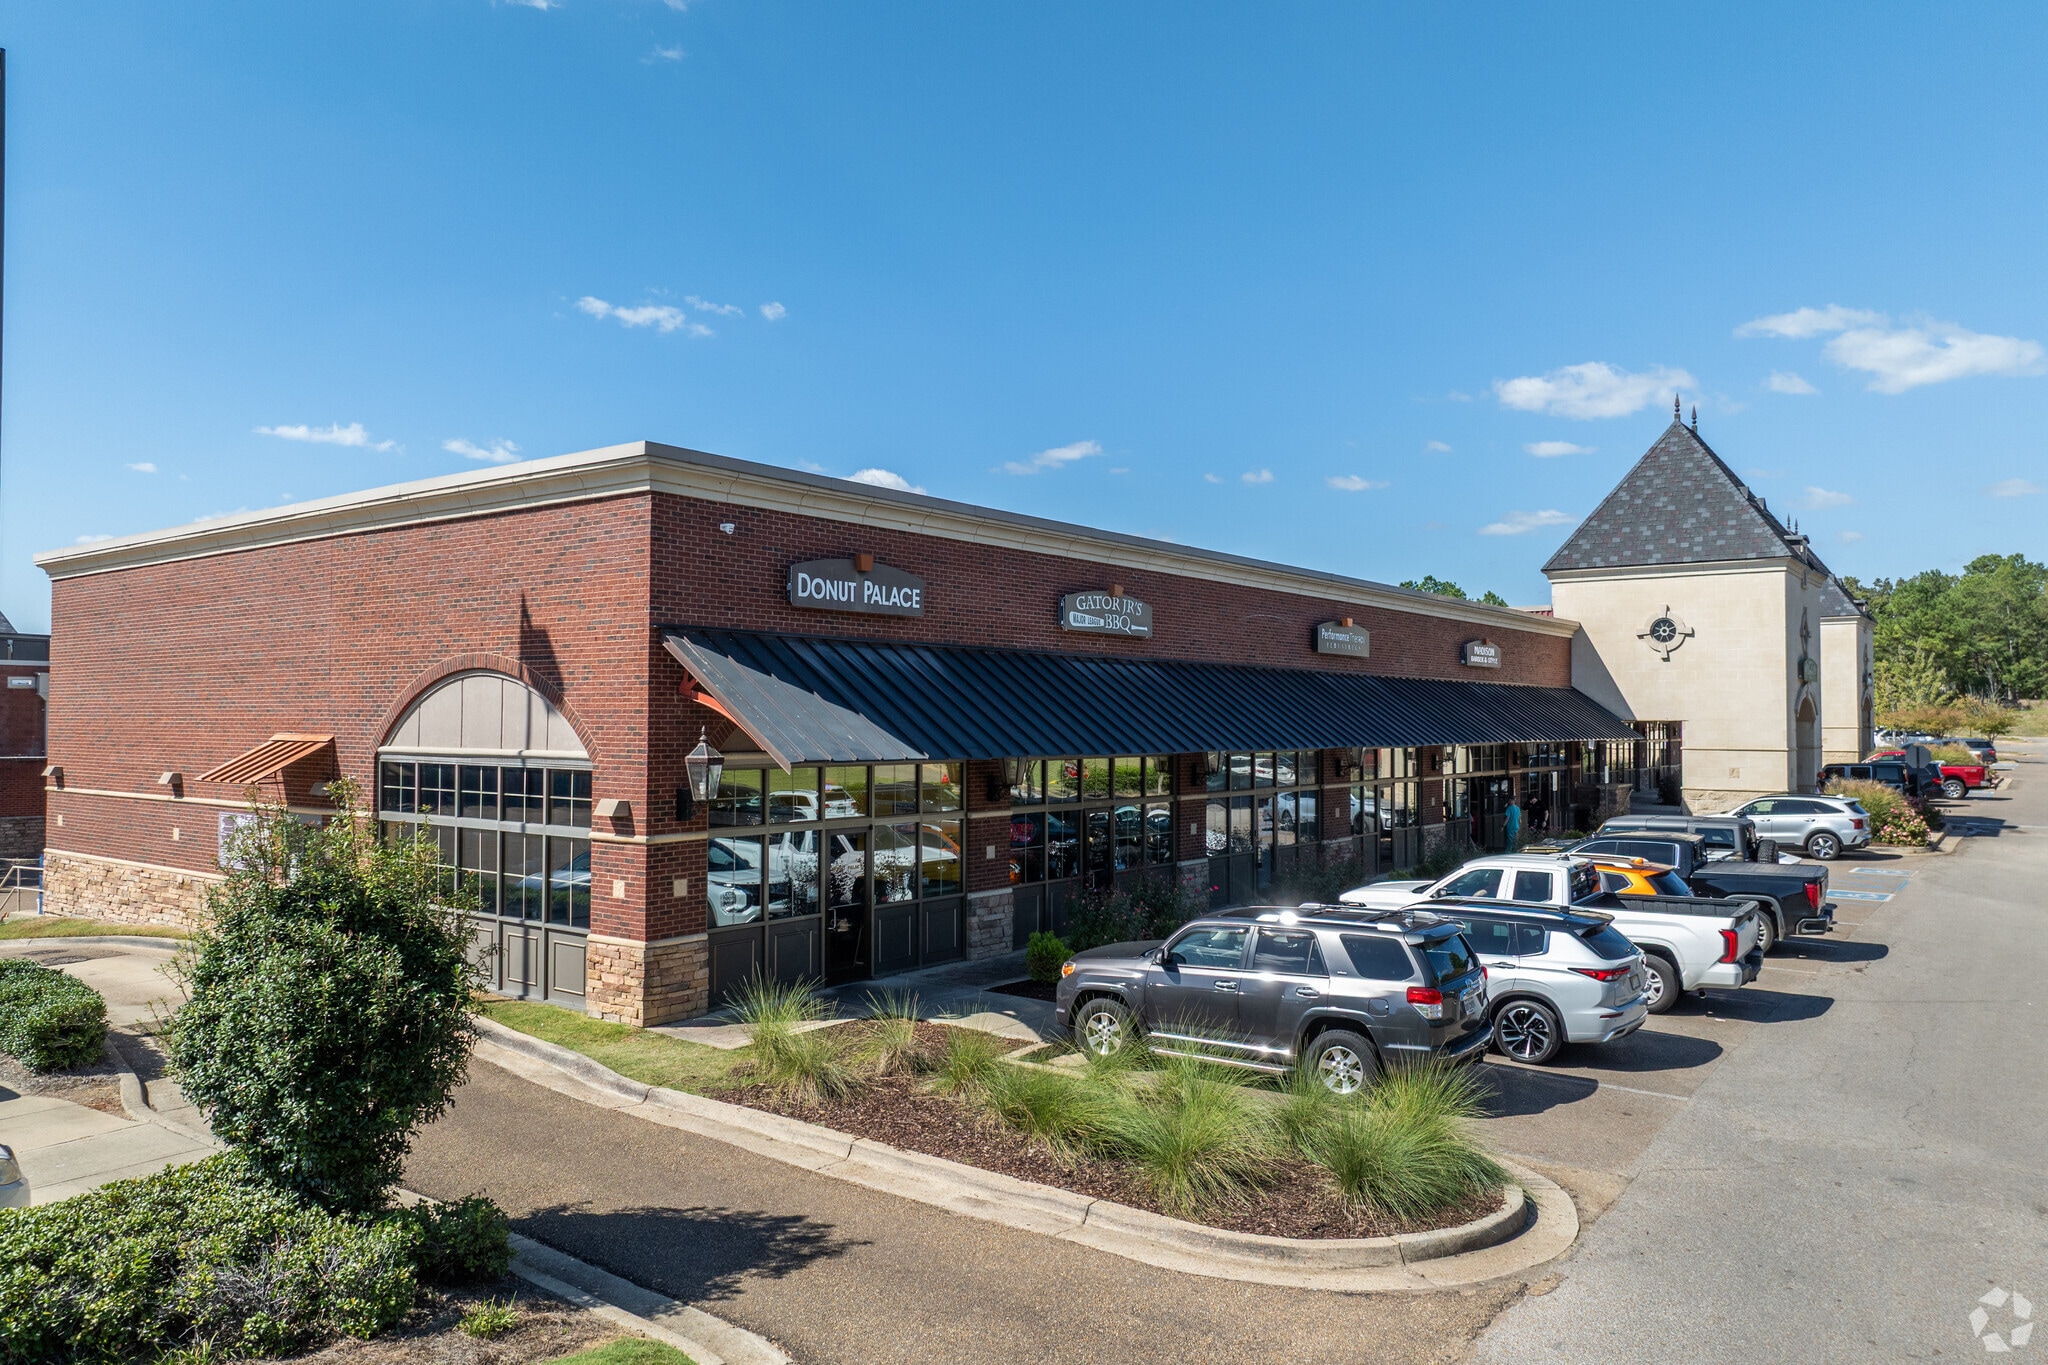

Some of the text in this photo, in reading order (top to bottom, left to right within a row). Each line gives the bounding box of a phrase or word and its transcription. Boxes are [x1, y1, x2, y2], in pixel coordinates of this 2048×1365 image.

[798, 573, 920, 608] DONUT PALACE
[1076, 595, 1142, 616] GATOR JR'S
[1072, 612, 1086, 624] MAJOR
[1104, 613, 1131, 634] BBQ
[1321, 628, 1350, 642] Performance
